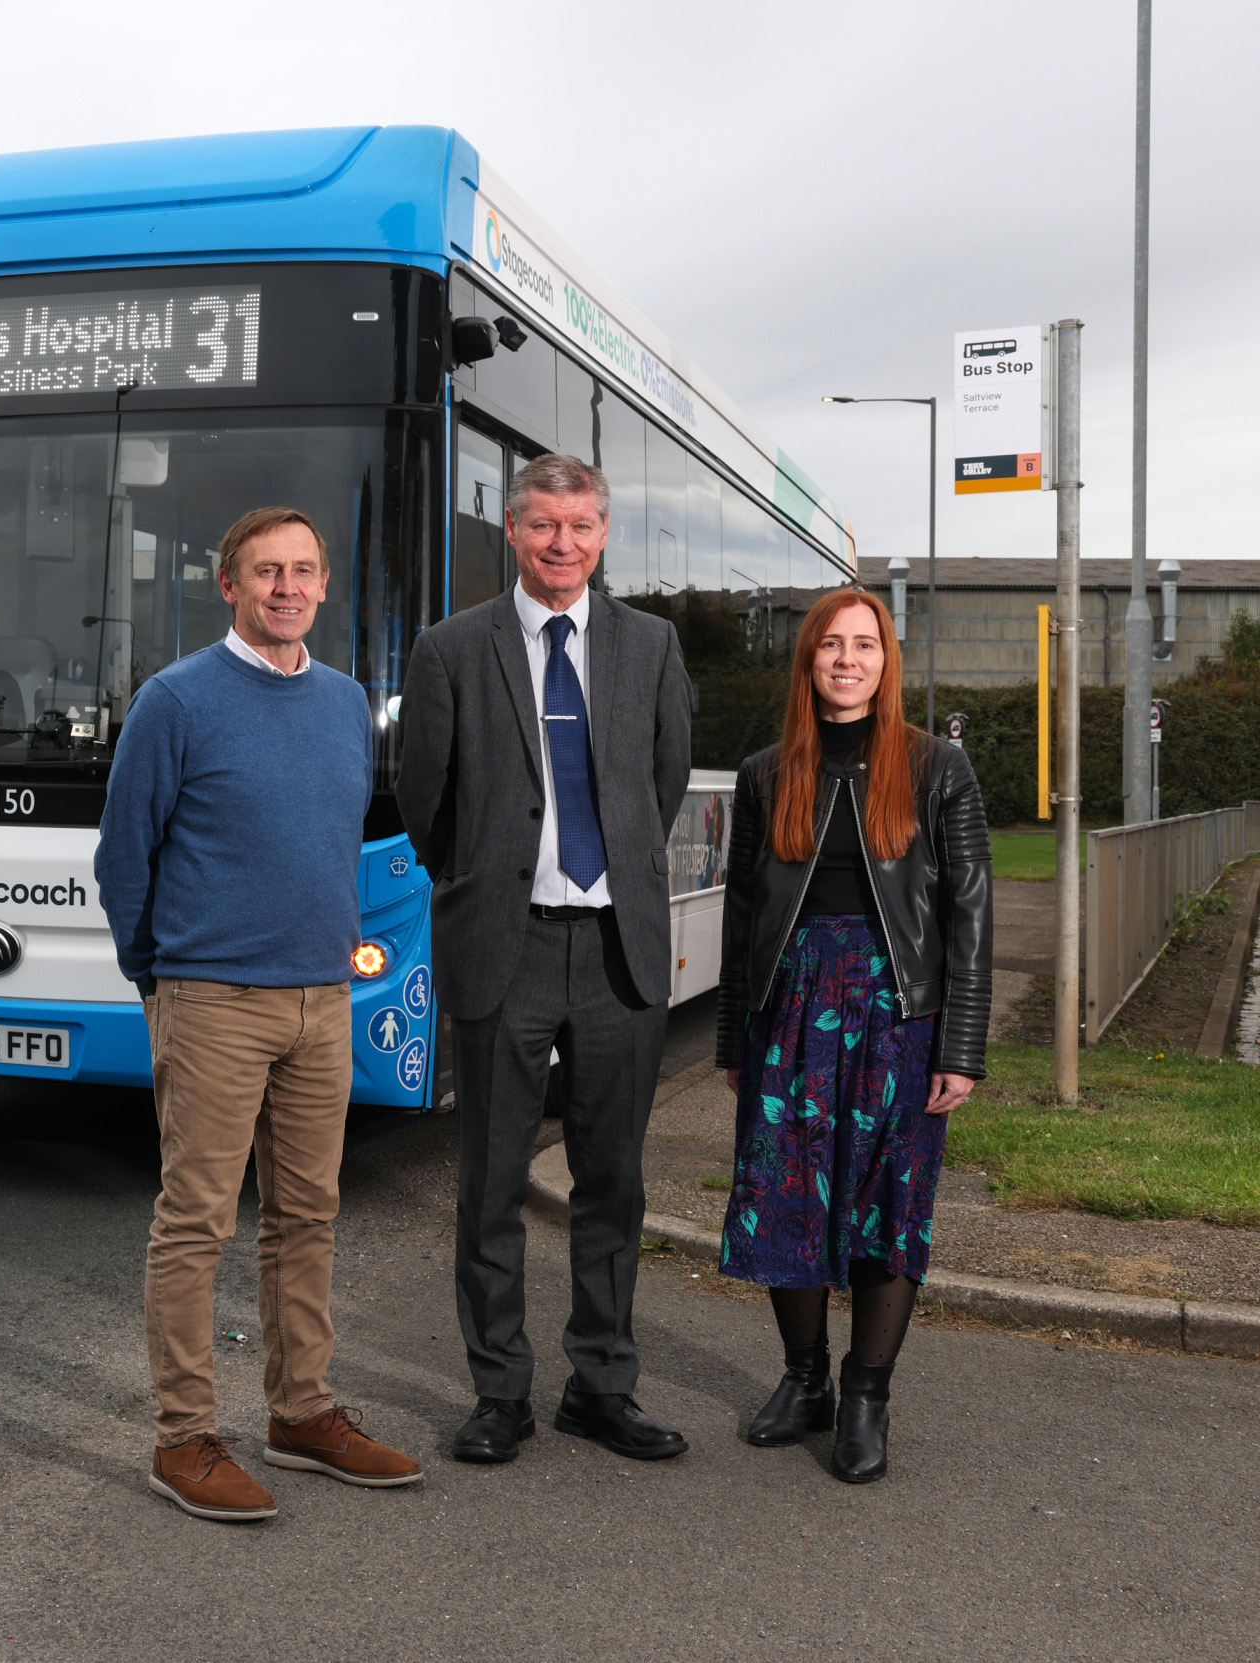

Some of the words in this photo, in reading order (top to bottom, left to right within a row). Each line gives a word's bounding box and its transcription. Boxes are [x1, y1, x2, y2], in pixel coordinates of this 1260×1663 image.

[501, 233, 554, 308] Stagecoach
[24, 299, 174, 357] Hospital
[186, 293, 261, 383] 31
[94, 353, 158, 388] Park
[963, 364, 992, 377] Bus
[996, 361, 1033, 375] Stop
[963, 392, 1002, 402] Saltview
[963, 403, 999, 413] Terrace
[962, 462, 984, 470] TEES
[1026, 462, 1034, 471] B
[7, 1031, 62, 1063] FFO
